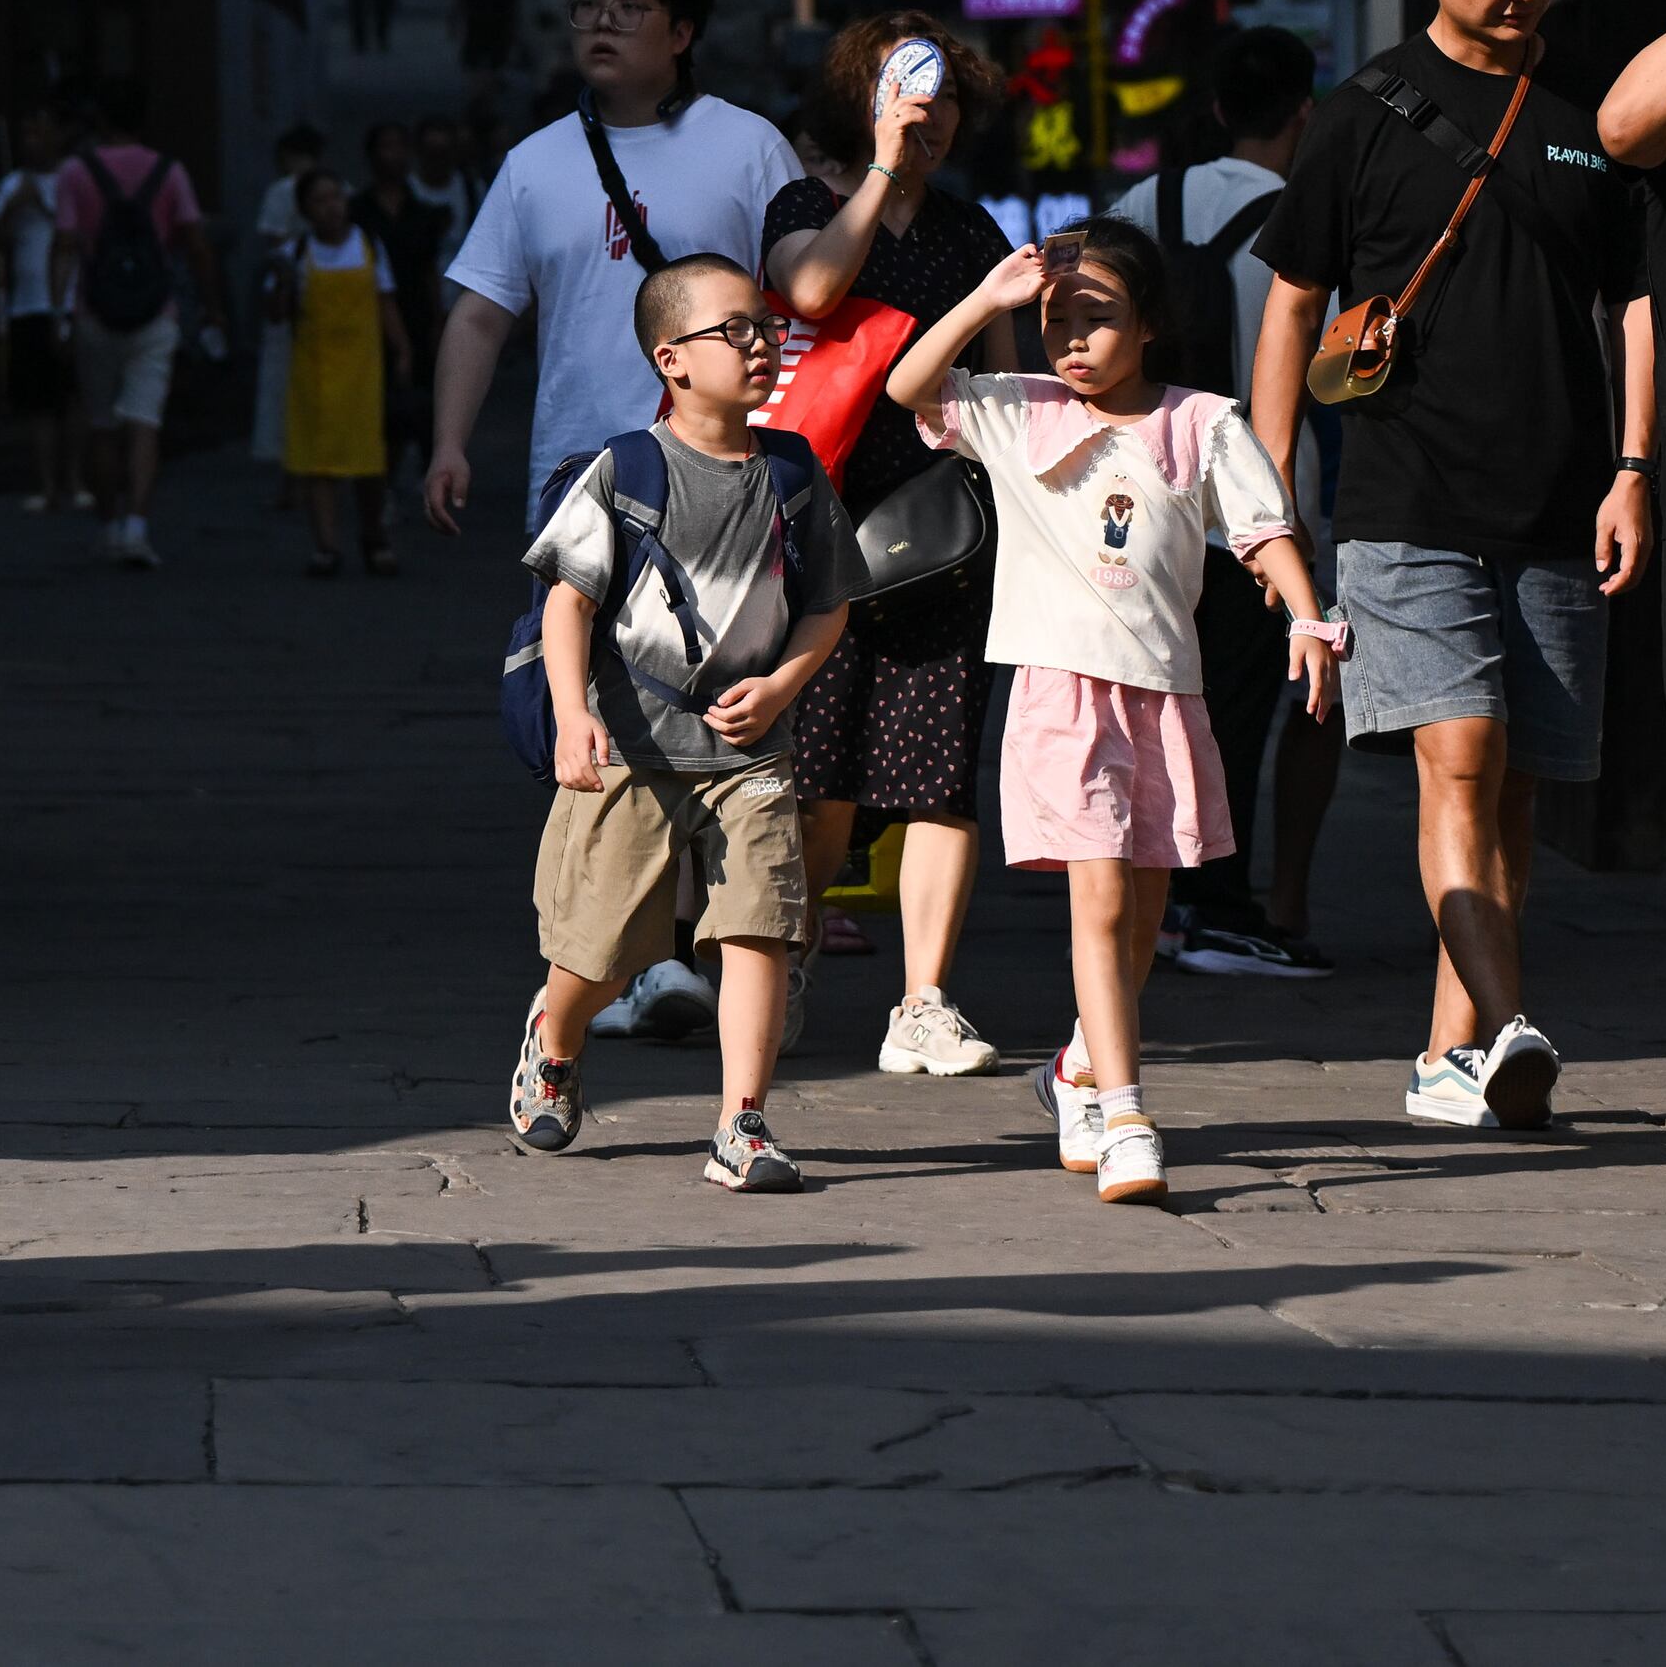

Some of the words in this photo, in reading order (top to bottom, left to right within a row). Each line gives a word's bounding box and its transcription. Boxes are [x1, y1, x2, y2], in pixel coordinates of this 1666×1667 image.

[1547, 145, 1589, 167] PLAYIN
[1590, 154, 1608, 173] BIG
[1095, 569, 1134, 587] 1988
[912, 1024, 931, 1045] N
